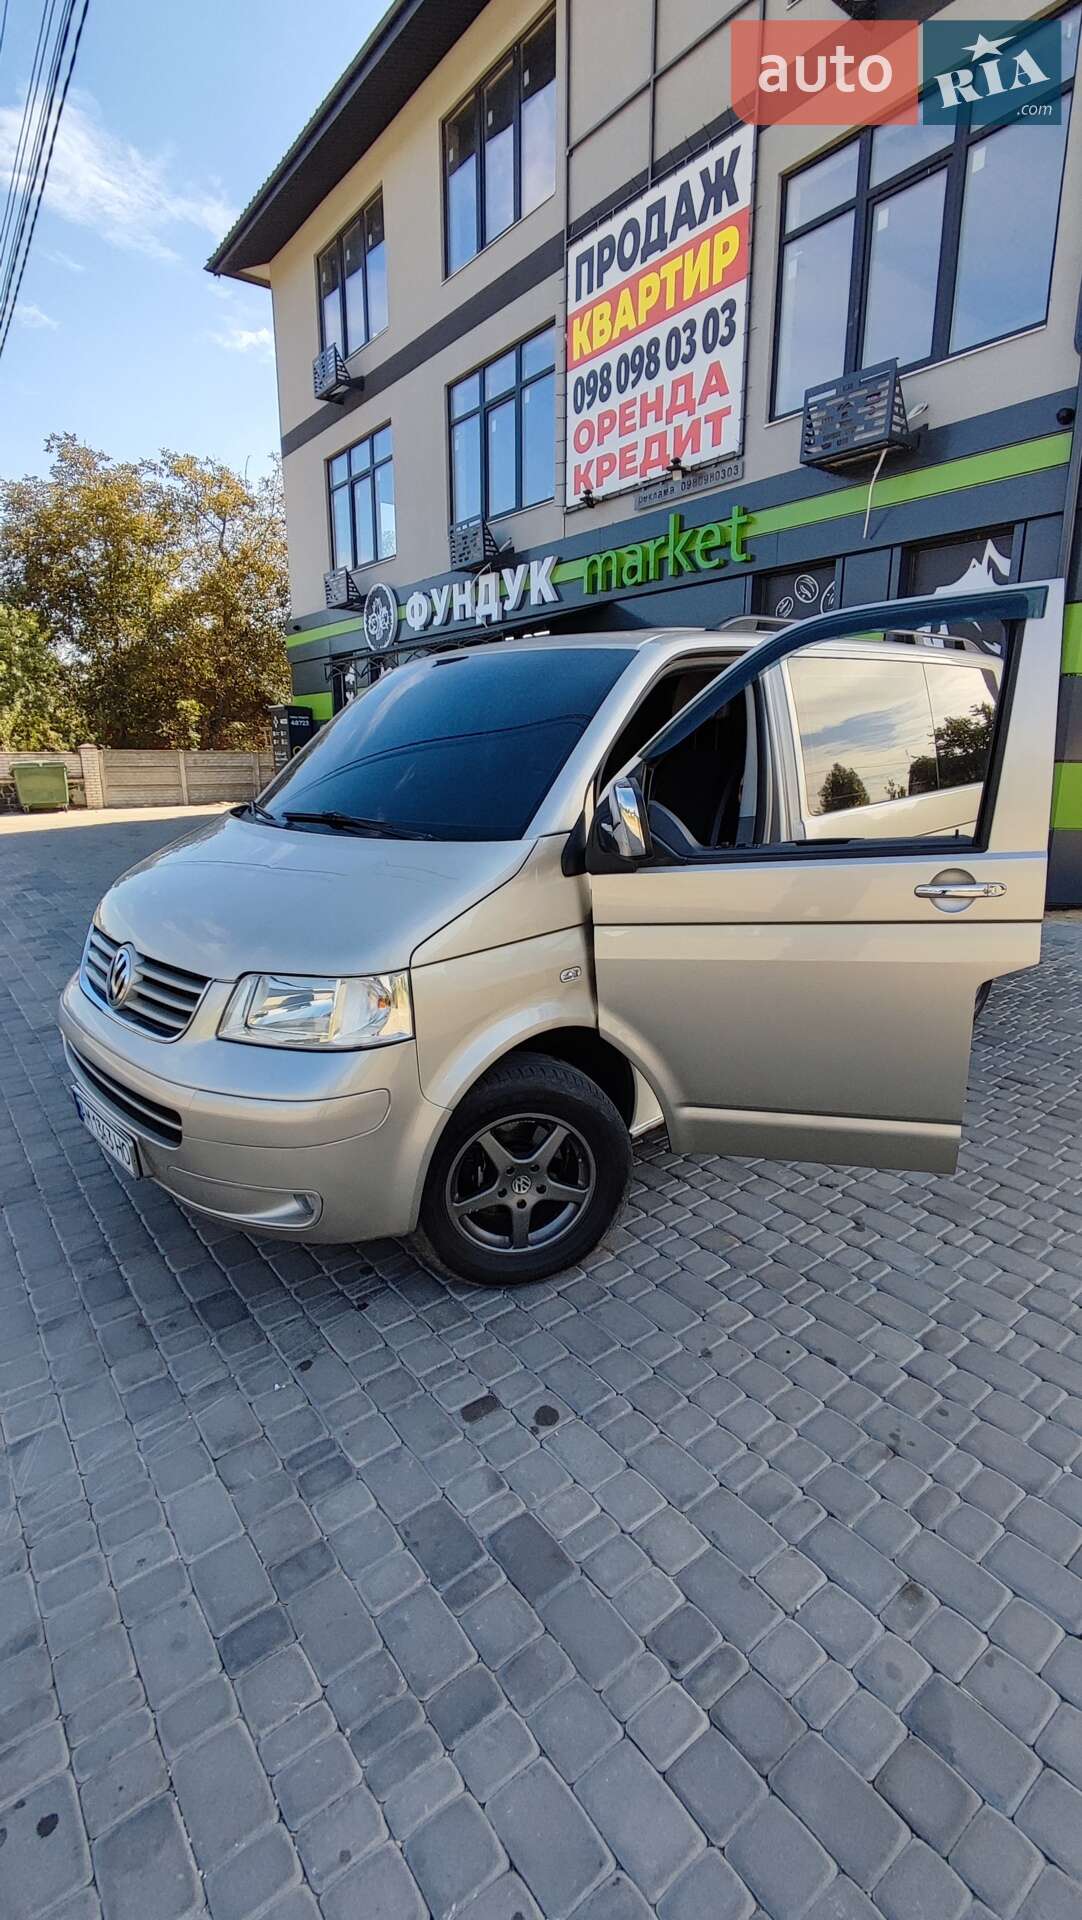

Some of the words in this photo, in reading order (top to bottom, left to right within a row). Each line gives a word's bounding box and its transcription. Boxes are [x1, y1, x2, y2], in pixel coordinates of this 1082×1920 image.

[575, 144, 742, 303] ПРОДАЖ
[572, 225, 741, 361] КВАРТИР
[573, 361, 612, 415] 098
[616, 336, 661, 395] 098
[665, 318, 697, 371] 03
[702, 298, 737, 354] 03
[573, 360, 730, 454] ОРЕНДА
[573, 405, 732, 496] КРЕДИТ
[404, 556, 560, 632] ФУНДУК
[583, 504, 753, 595] market
